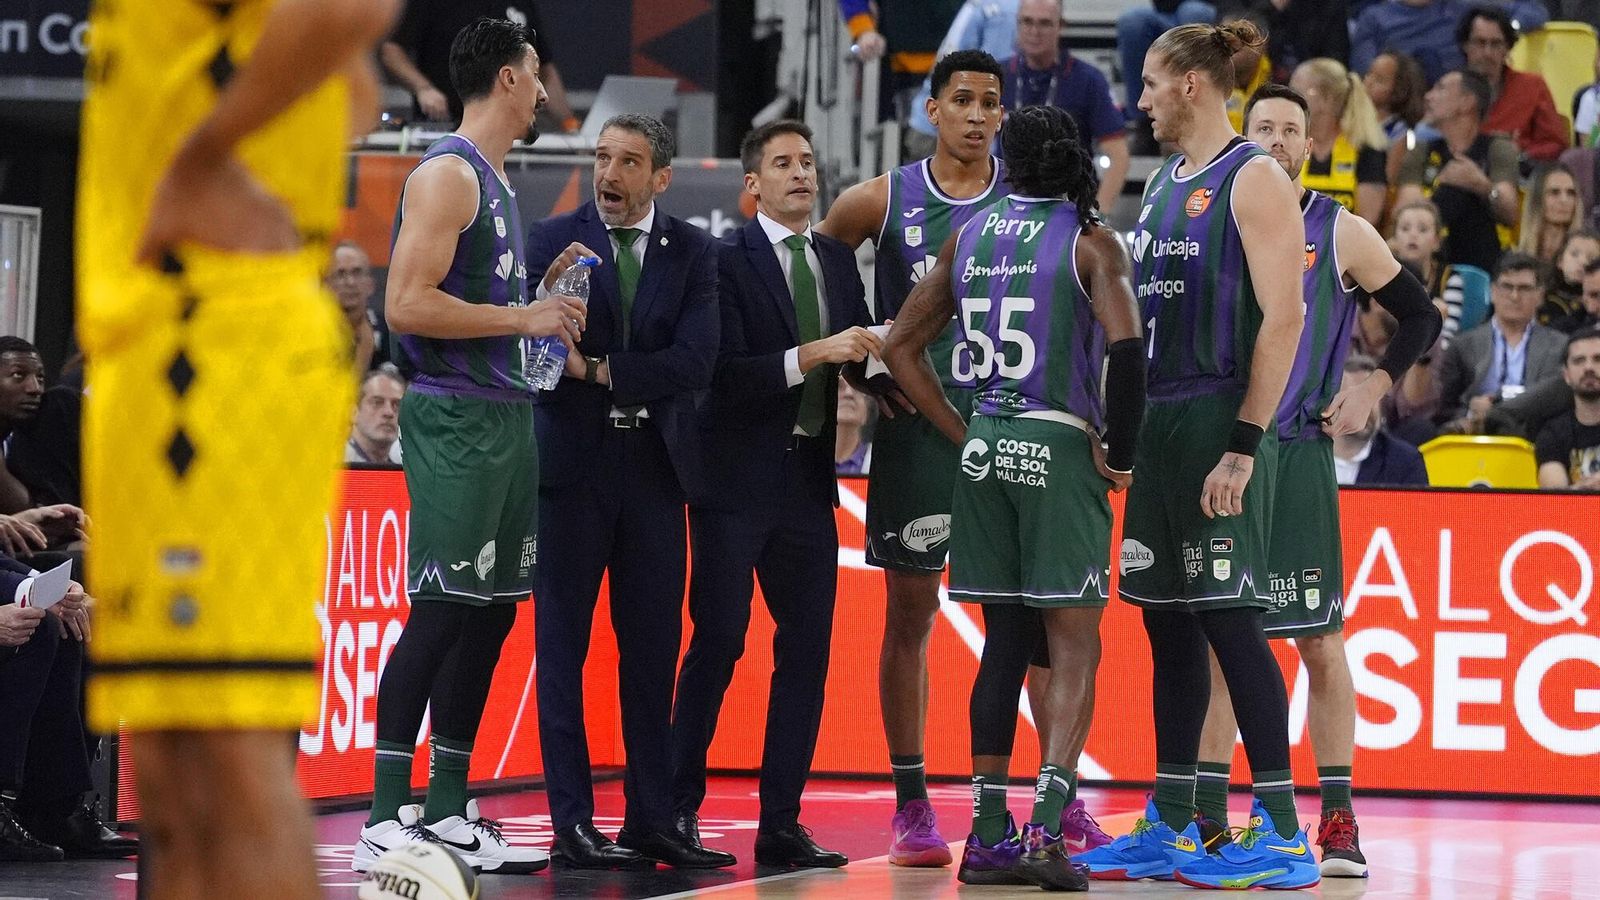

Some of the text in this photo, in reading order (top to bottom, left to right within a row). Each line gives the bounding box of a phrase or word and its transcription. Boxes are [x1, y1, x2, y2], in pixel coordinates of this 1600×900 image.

[981, 212, 1045, 243] Perry
[1152, 237, 1200, 261] Unicaja
[961, 297, 1036, 380] 55
[996, 438, 1051, 461] COSTA
[995, 455, 1049, 475] DEL SOL
[996, 468, 1047, 489] MÁLAGA
